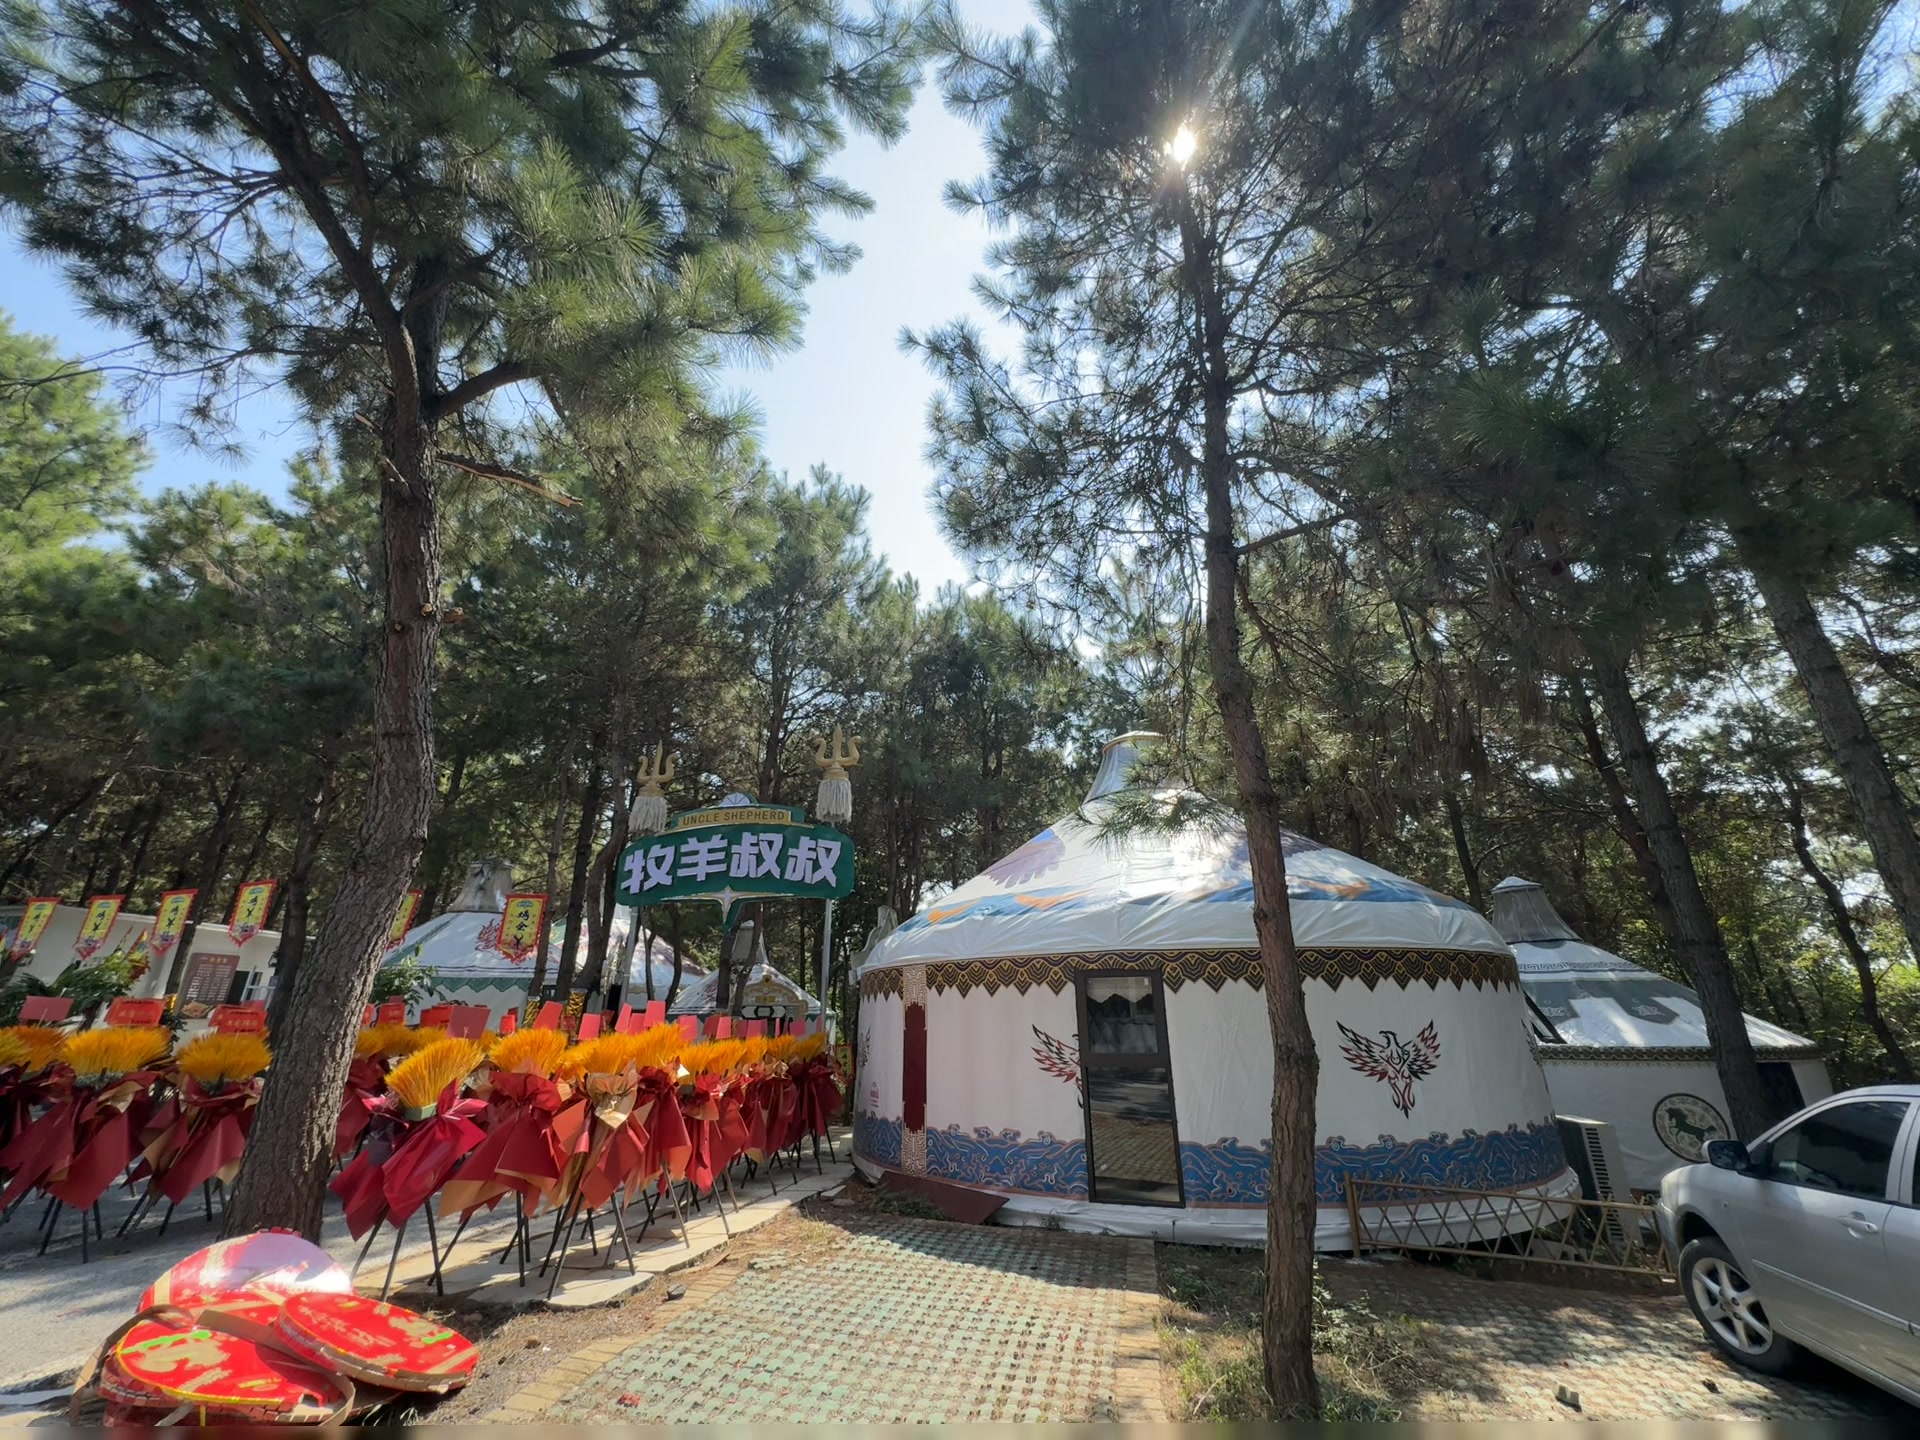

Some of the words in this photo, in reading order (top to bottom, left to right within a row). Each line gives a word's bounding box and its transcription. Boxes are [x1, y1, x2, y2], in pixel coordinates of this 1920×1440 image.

[682, 812, 720, 826] UNCLE
[723, 810, 785, 821] SHEPHERD
[620, 831, 843, 895] 牧羊叔叔
